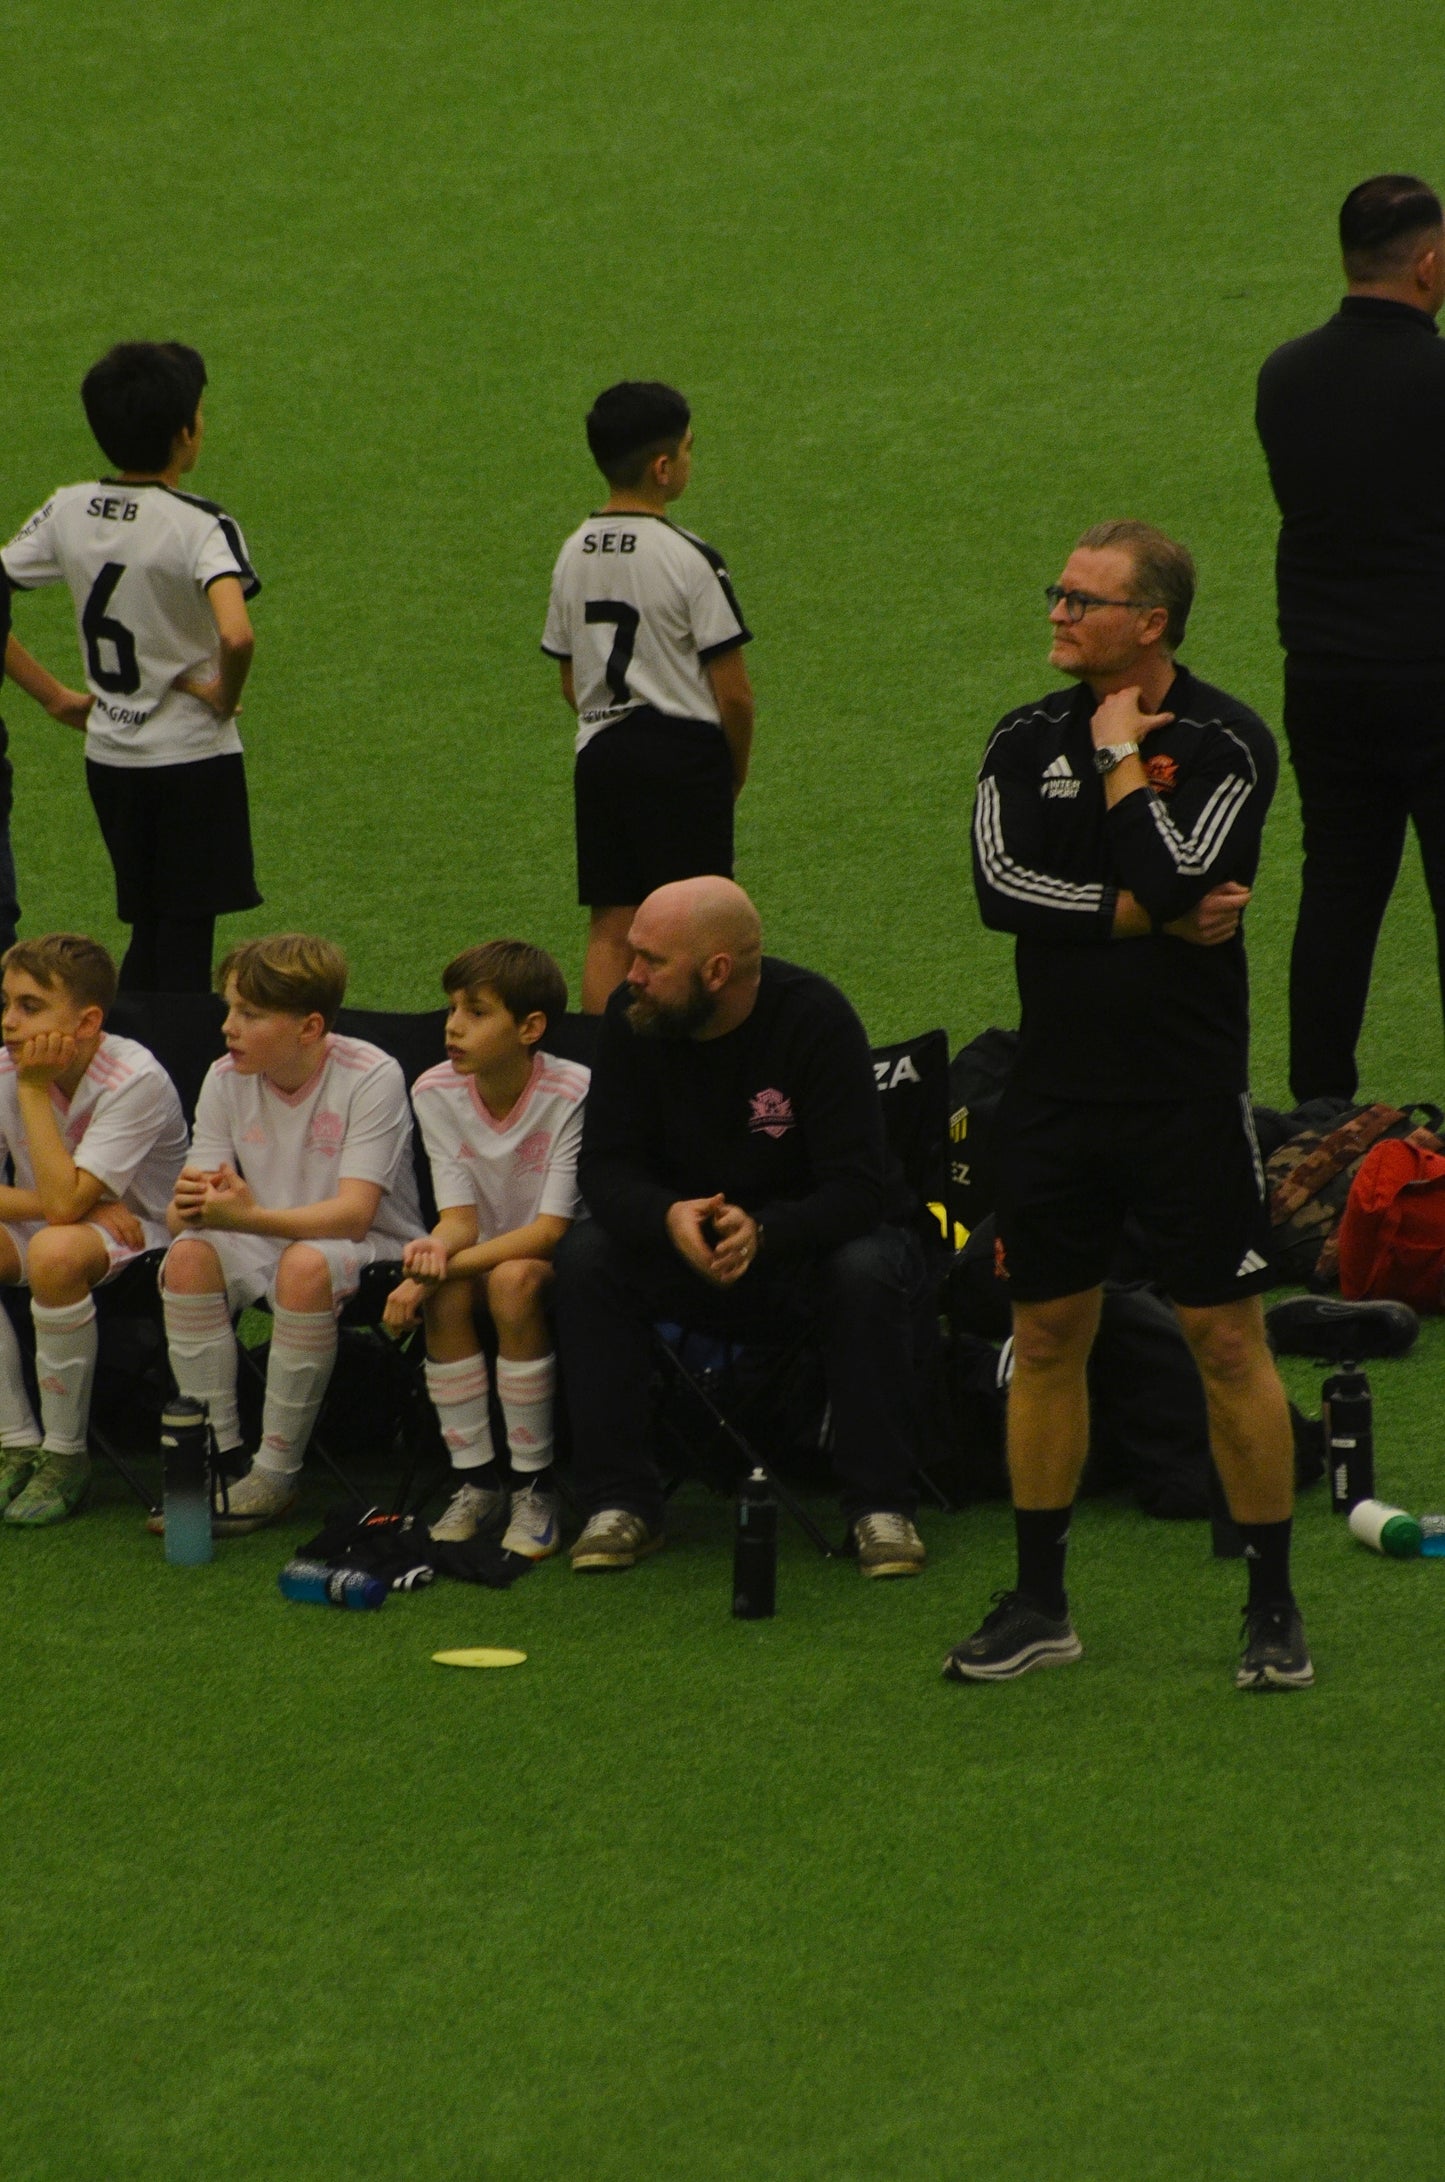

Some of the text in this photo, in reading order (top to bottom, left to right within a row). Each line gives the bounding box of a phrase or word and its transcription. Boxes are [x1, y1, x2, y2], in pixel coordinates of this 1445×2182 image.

[87, 497, 139, 522] SEB
[583, 533, 637, 554] SEB
[83, 562, 140, 694] 6
[585, 601, 639, 706] 7
